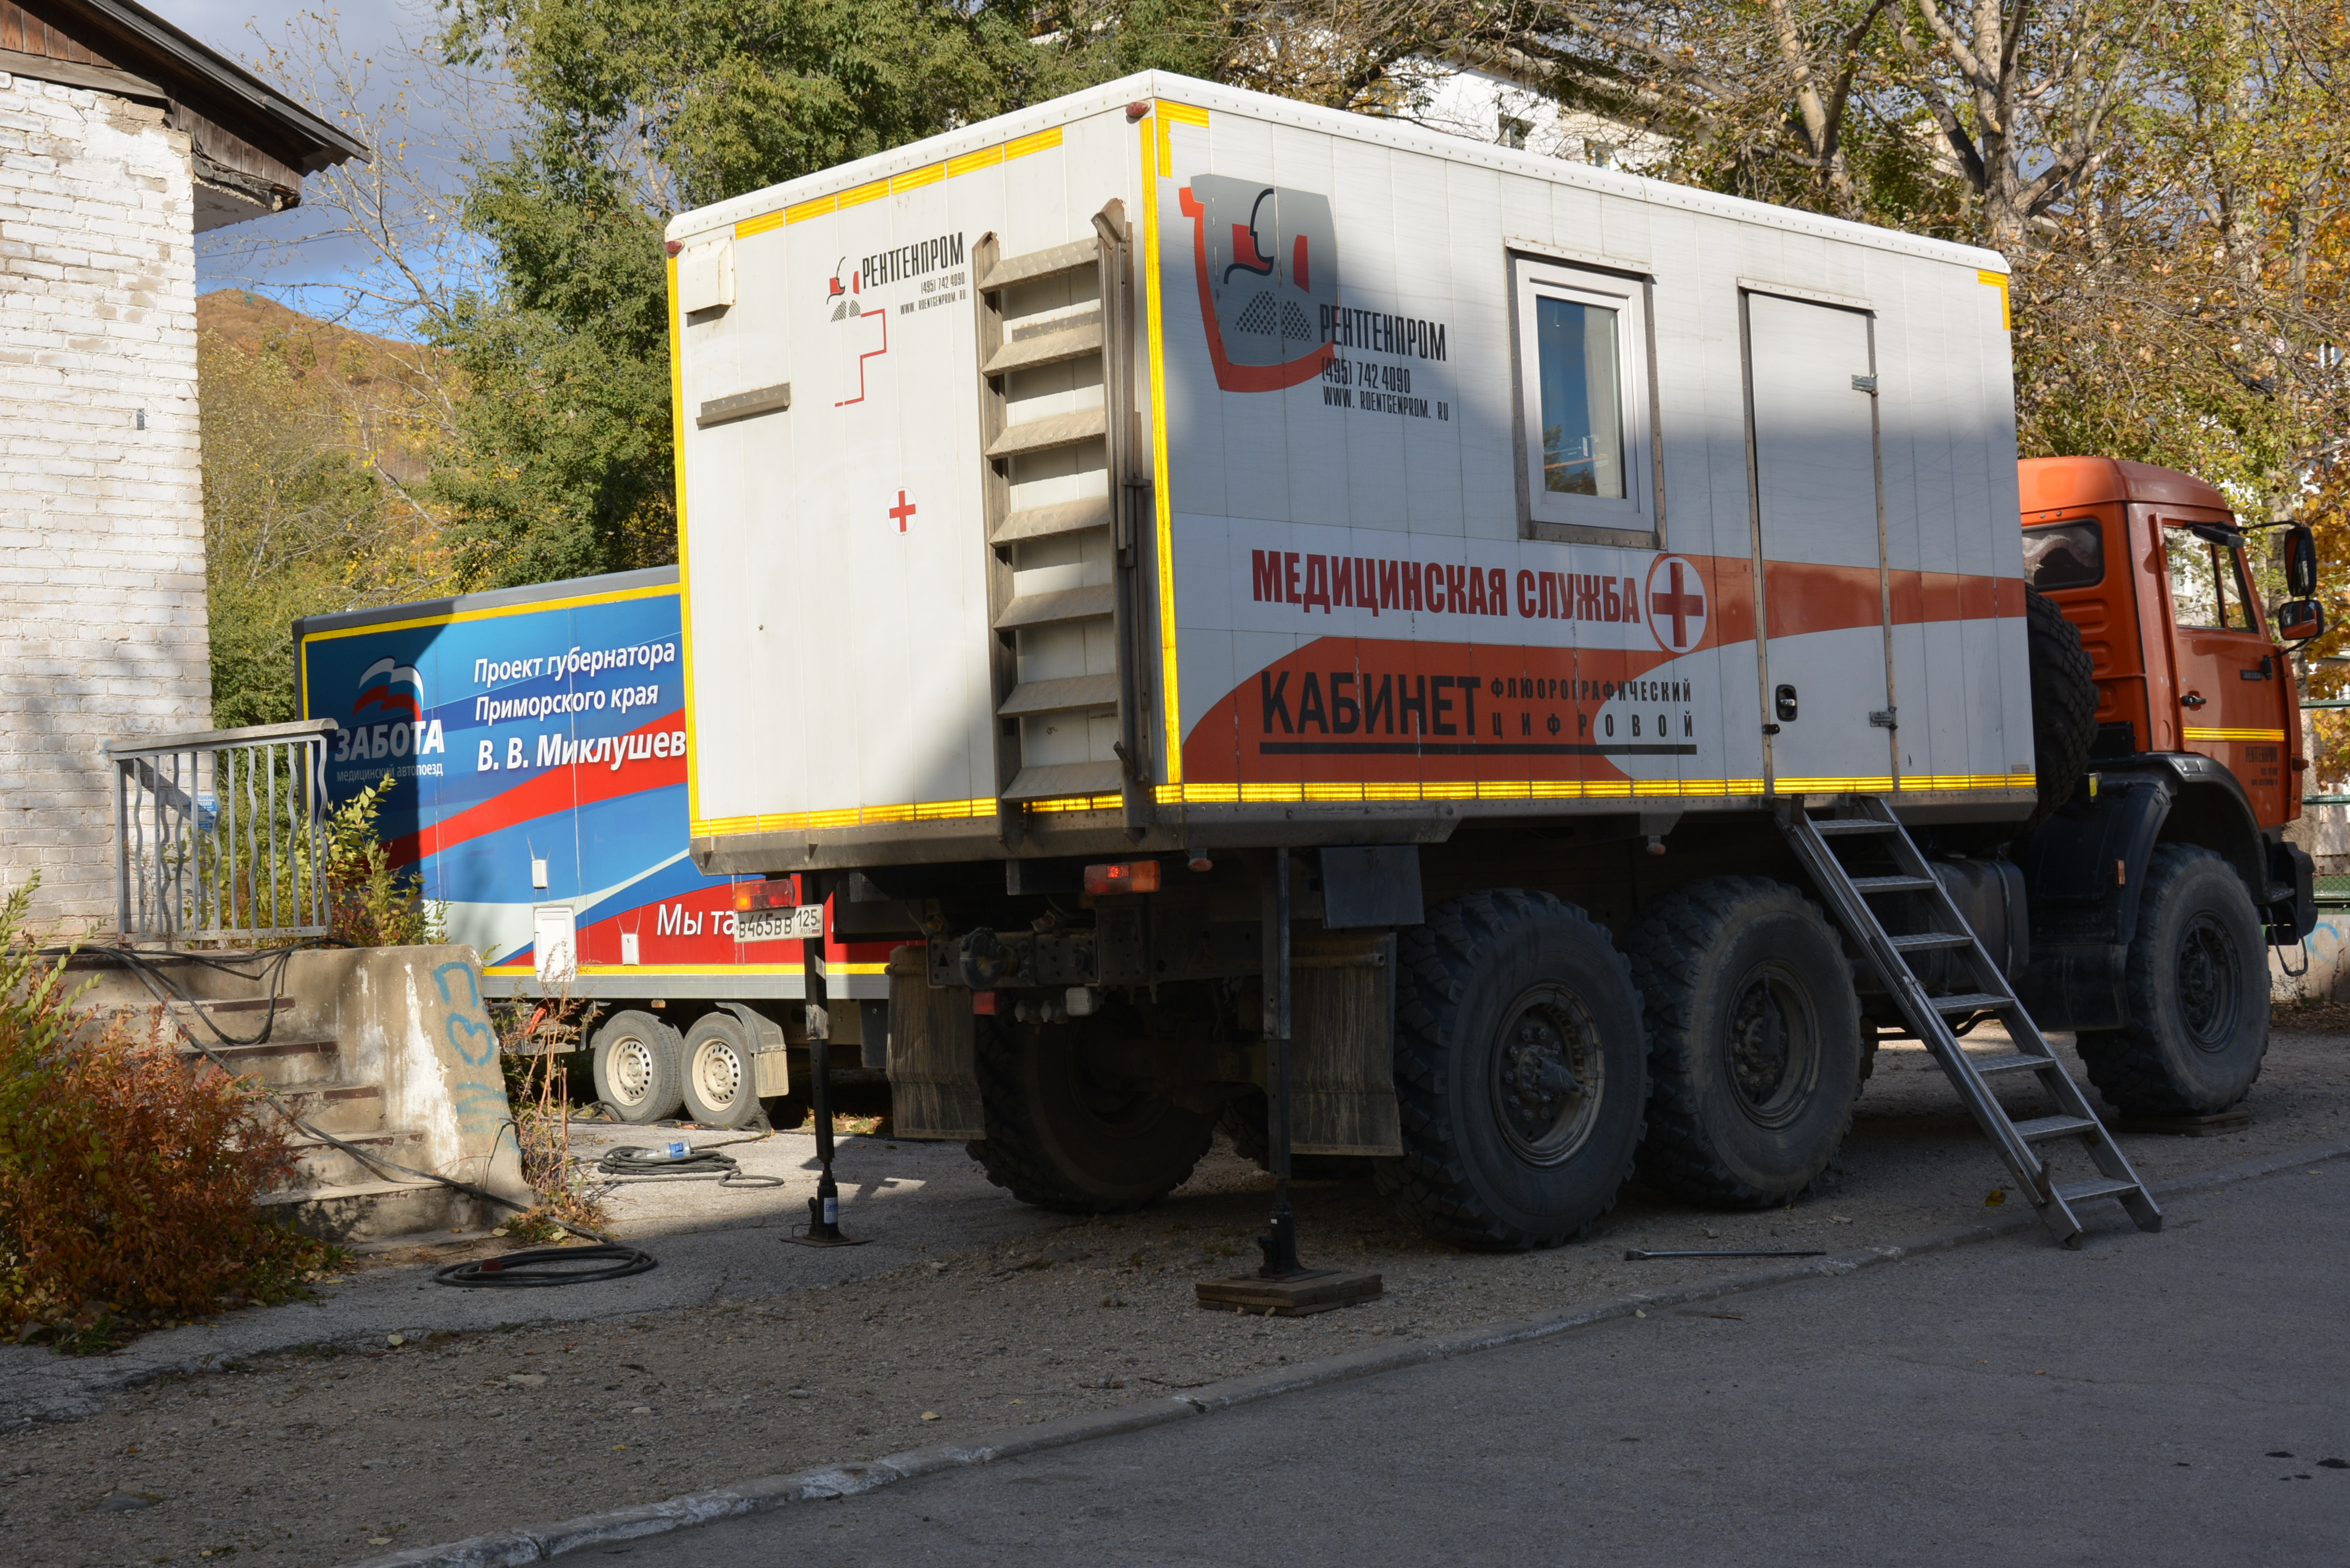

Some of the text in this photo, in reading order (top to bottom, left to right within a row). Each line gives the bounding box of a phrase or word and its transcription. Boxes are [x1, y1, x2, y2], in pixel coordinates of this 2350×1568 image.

[862, 232, 964, 289] РЕНТГЕНПРОМ
[921, 272, 965, 294] (495) 742 4090
[1319, 304, 1446, 361] РЕНТГЕНПРОМ
[1322, 357, 1410, 394] (495) 742 4090
[1437, 401, 1448, 421] RU
[1251, 549, 1640, 624] МЕДИЦИНСКАЯ СЛУЖБА
[474, 641, 675, 687] Проект губернатора
[475, 685, 659, 726] Приморского края
[1261, 671, 1692, 736] КАБИНЕТ ФЛЮОРОГРАФИЧЕСКИЙ
[335, 719, 445, 762] ЗАБОТА
[1492, 710, 1693, 739] ЦИФРОВОЙ
[337, 762, 443, 782] медицинский автопоезд
[478, 740, 499, 771] В.
[506, 737, 528, 769] В.
[656, 904, 702, 936] Мы
[797, 909, 817, 927] 125
